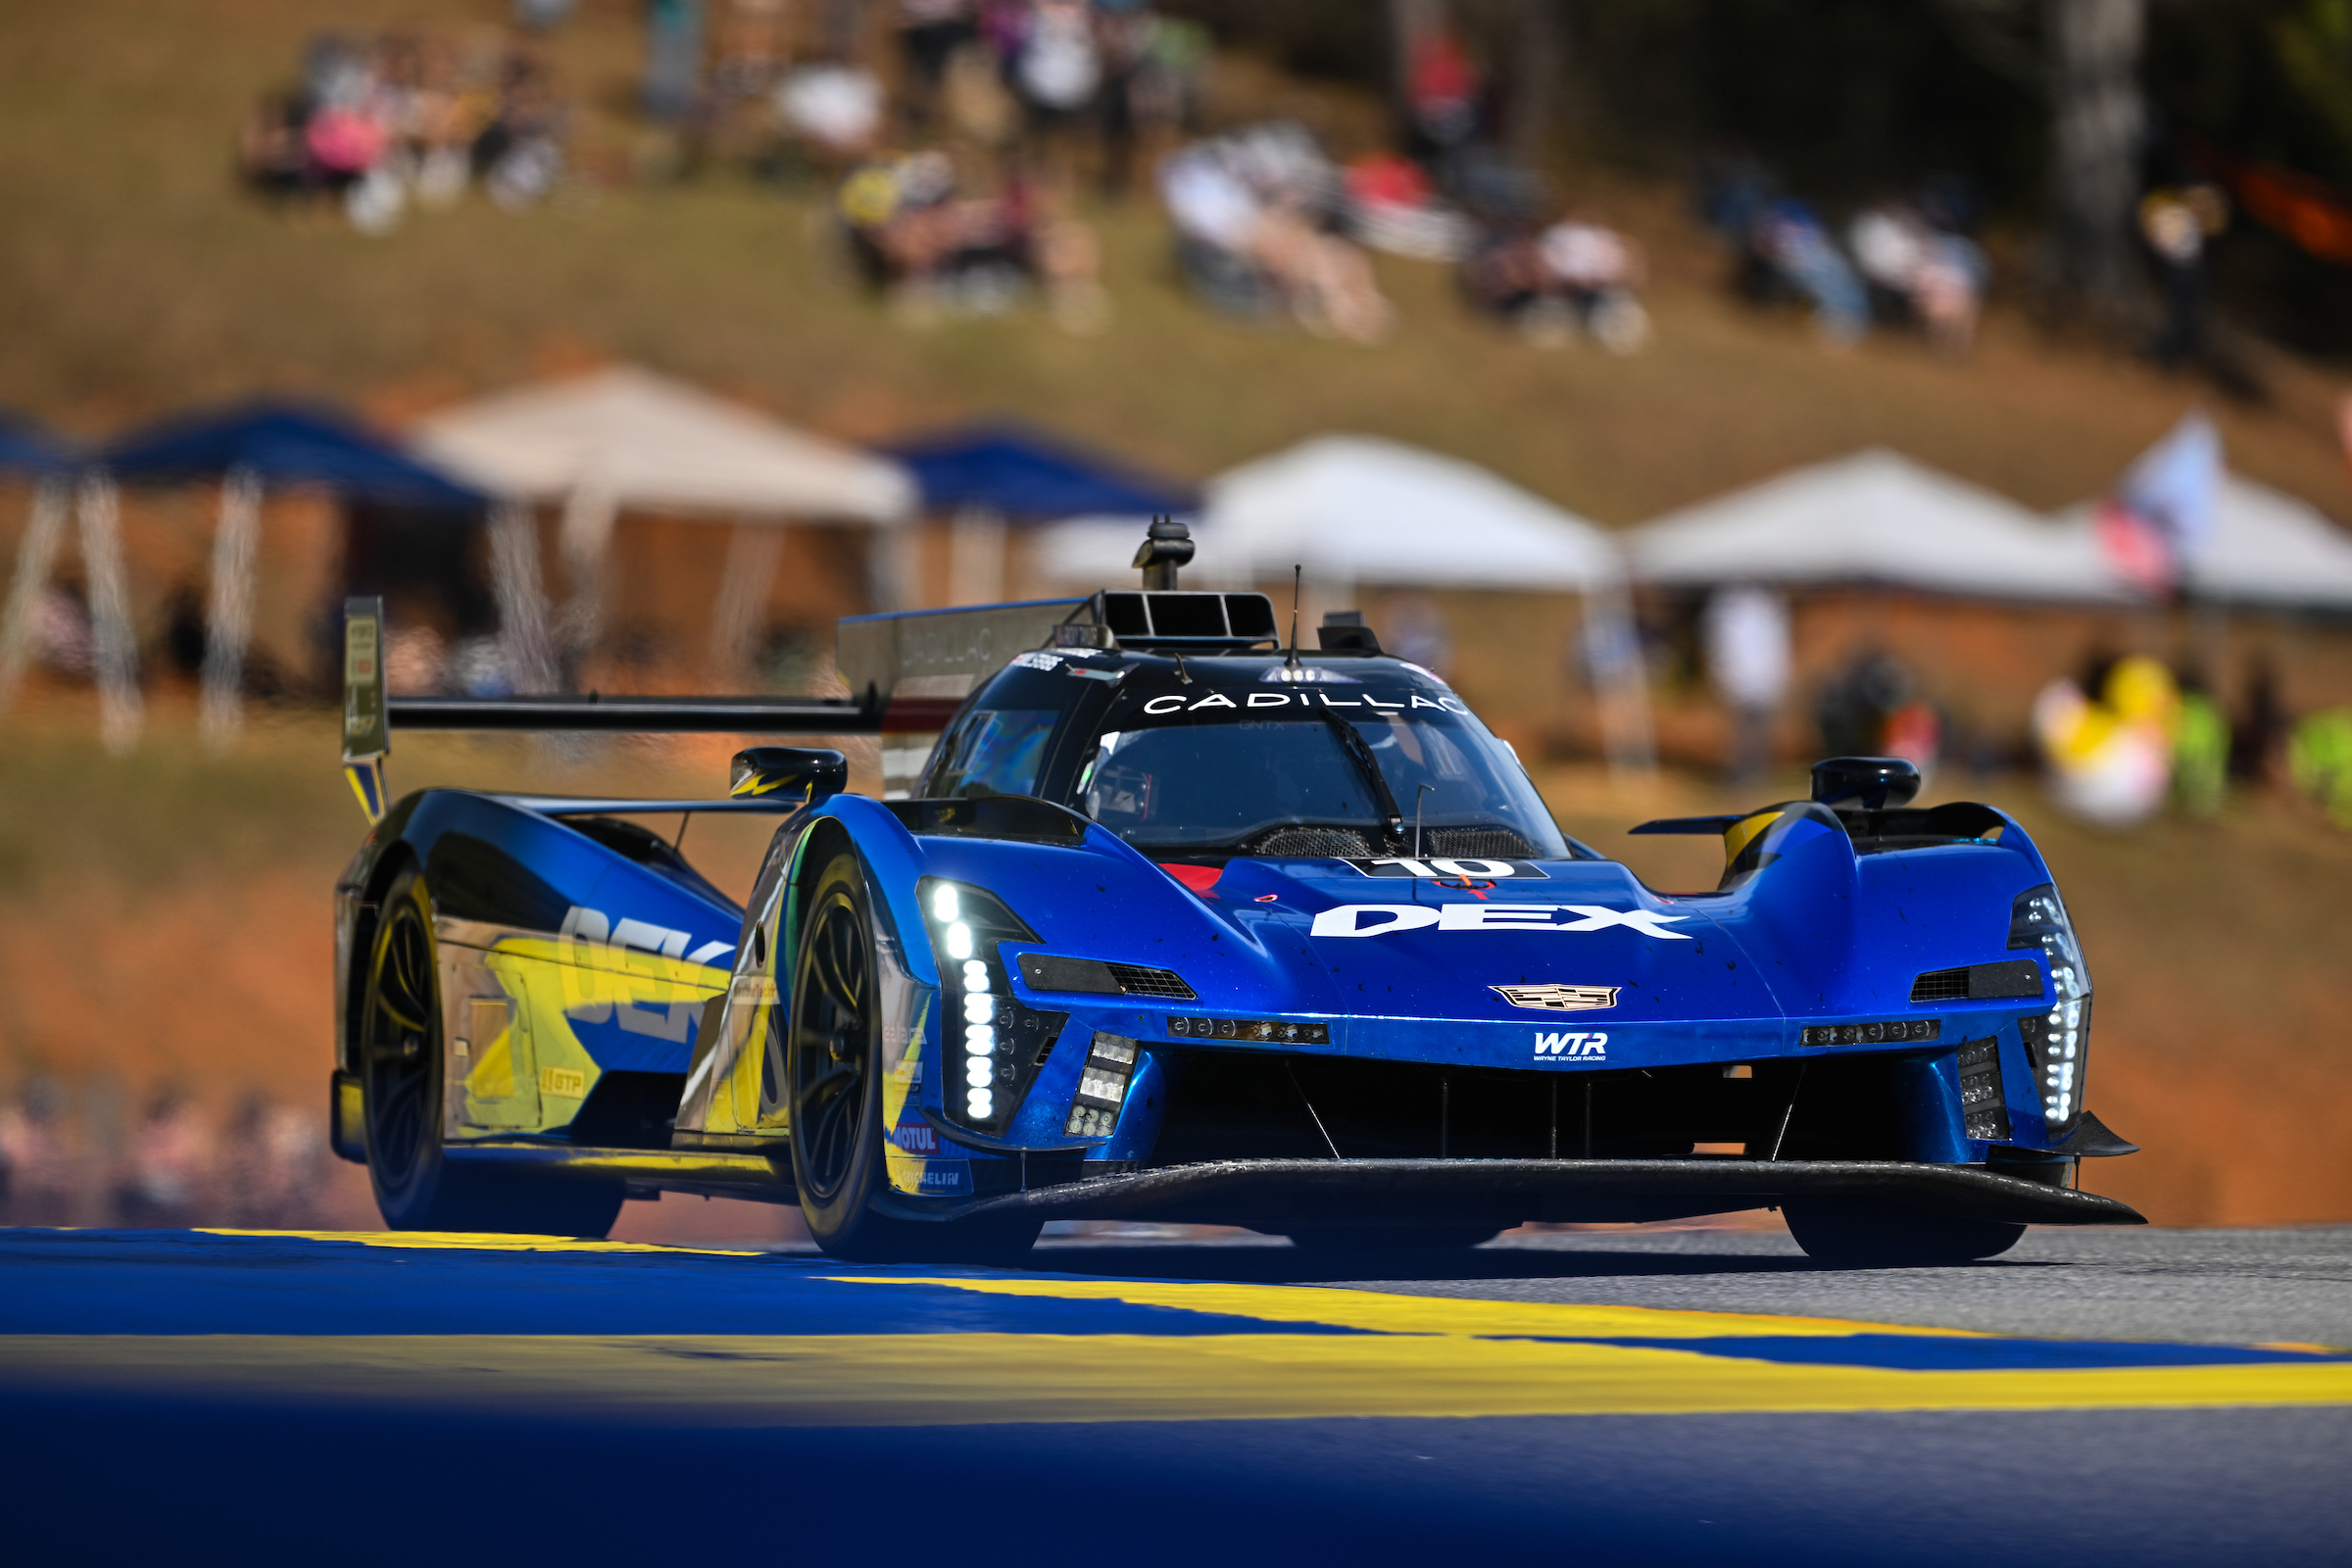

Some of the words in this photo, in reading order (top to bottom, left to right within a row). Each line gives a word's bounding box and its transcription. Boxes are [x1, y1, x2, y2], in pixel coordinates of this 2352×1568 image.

[1143, 693, 1469, 715] CADILLAC
[1371, 858, 1516, 878] 10
[1309, 904, 1694, 939] DEX
[1535, 1032, 1608, 1055] WTR
[554, 1073, 582, 1093] GTP
[893, 1126, 936, 1151] MOTUL
[904, 1171, 959, 1186] MICHELIN
